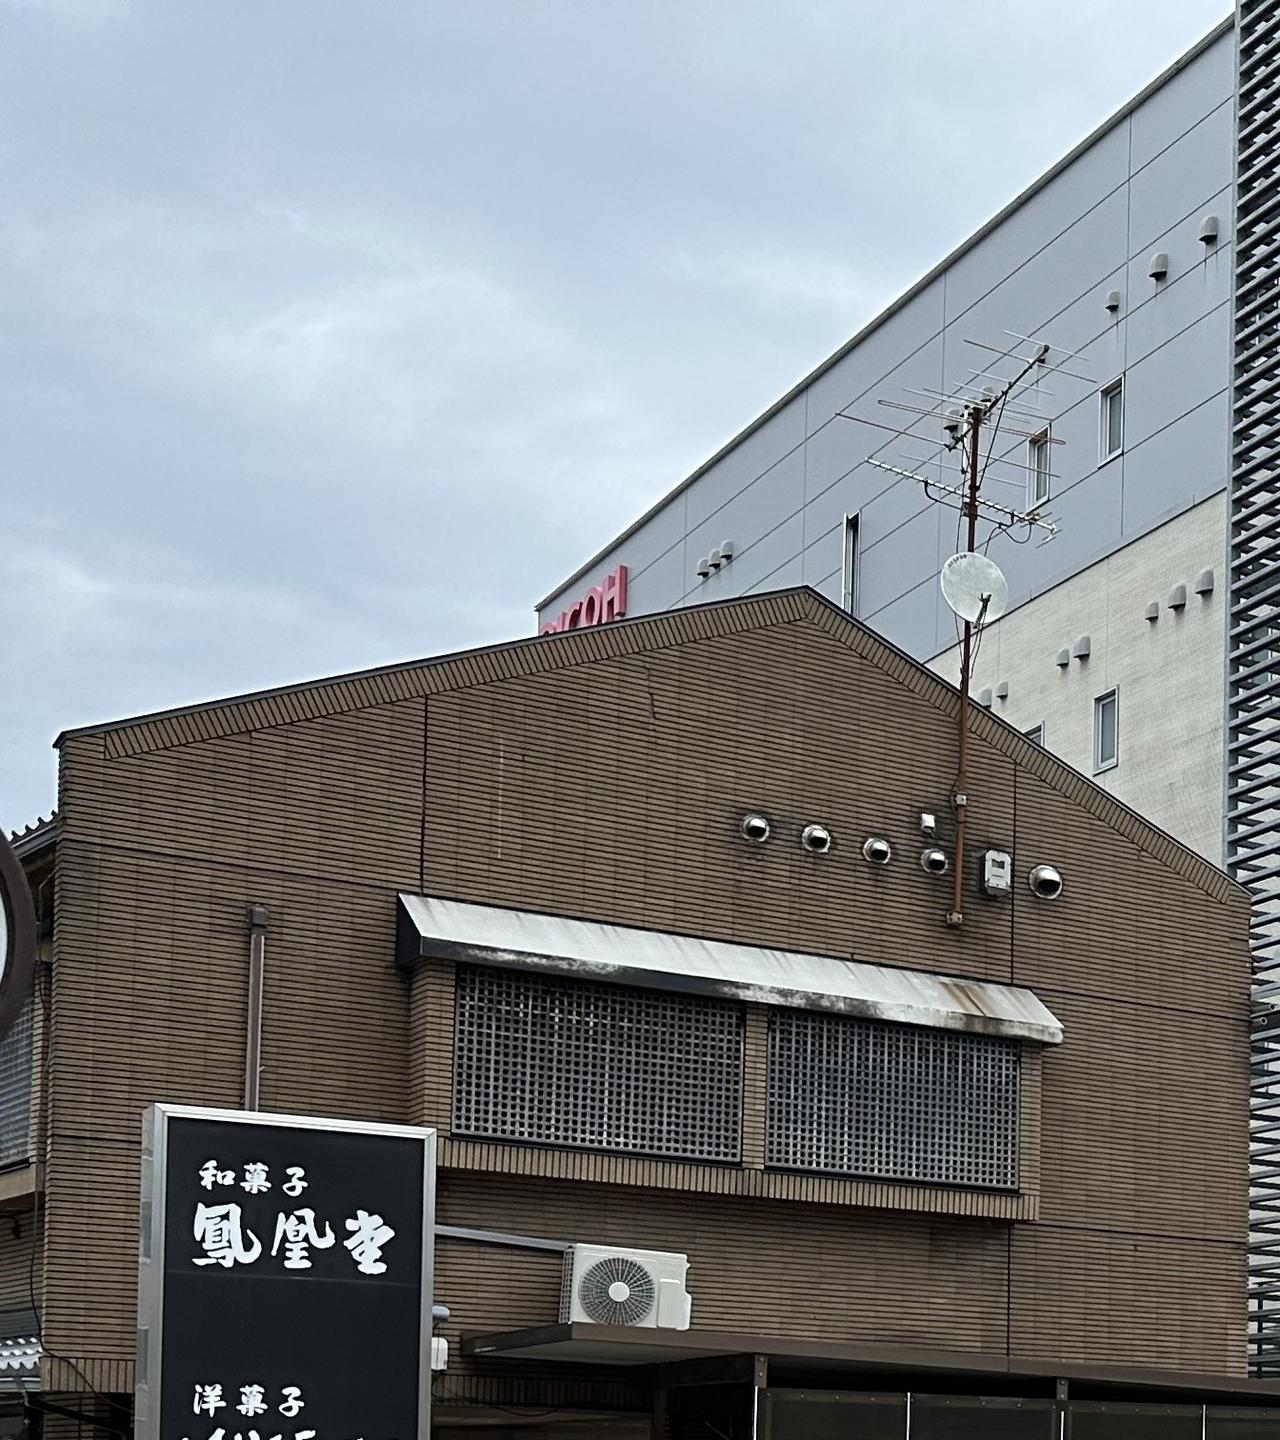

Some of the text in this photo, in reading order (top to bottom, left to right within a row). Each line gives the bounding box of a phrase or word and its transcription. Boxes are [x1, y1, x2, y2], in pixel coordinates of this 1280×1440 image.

[199, 1159, 308, 1197] 和菓子
[192, 1202, 395, 1275] 鳳凰堂
[193, 1383, 305, 1418] 洋菓子
